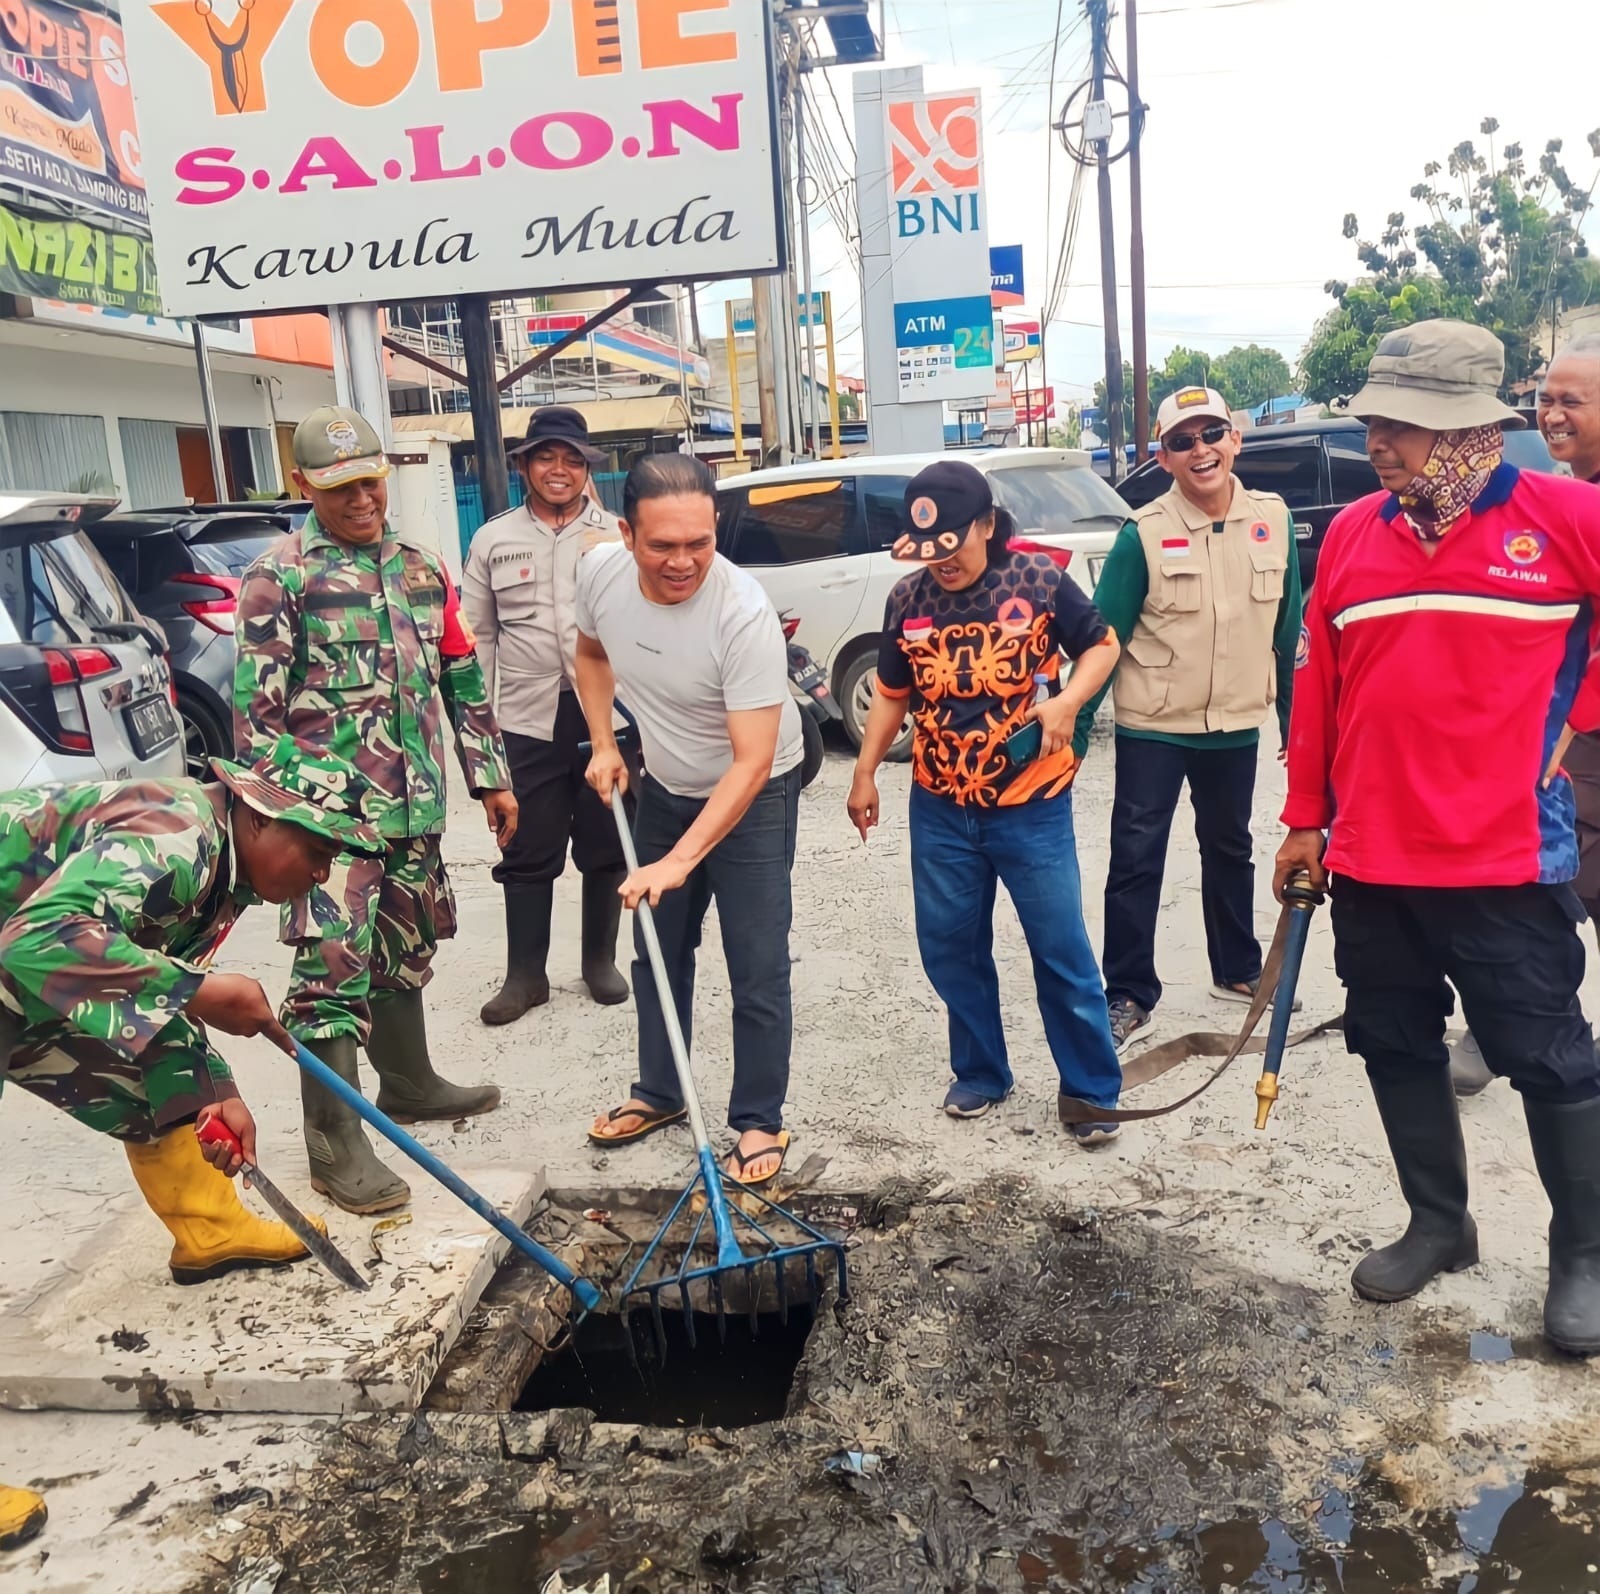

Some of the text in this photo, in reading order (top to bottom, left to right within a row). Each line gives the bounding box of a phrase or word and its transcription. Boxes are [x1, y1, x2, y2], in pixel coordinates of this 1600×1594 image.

[148, 0, 737, 115] YOPIE
[174, 93, 744, 205] S.A.L.O.N
[896, 192, 980, 237] BNI
[185, 218, 480, 291] Kawula
[520, 195, 740, 260] Muda
[904, 315, 946, 334] ATM
[955, 326, 990, 357] 24
[1488, 565, 1548, 584] RELAWAN
